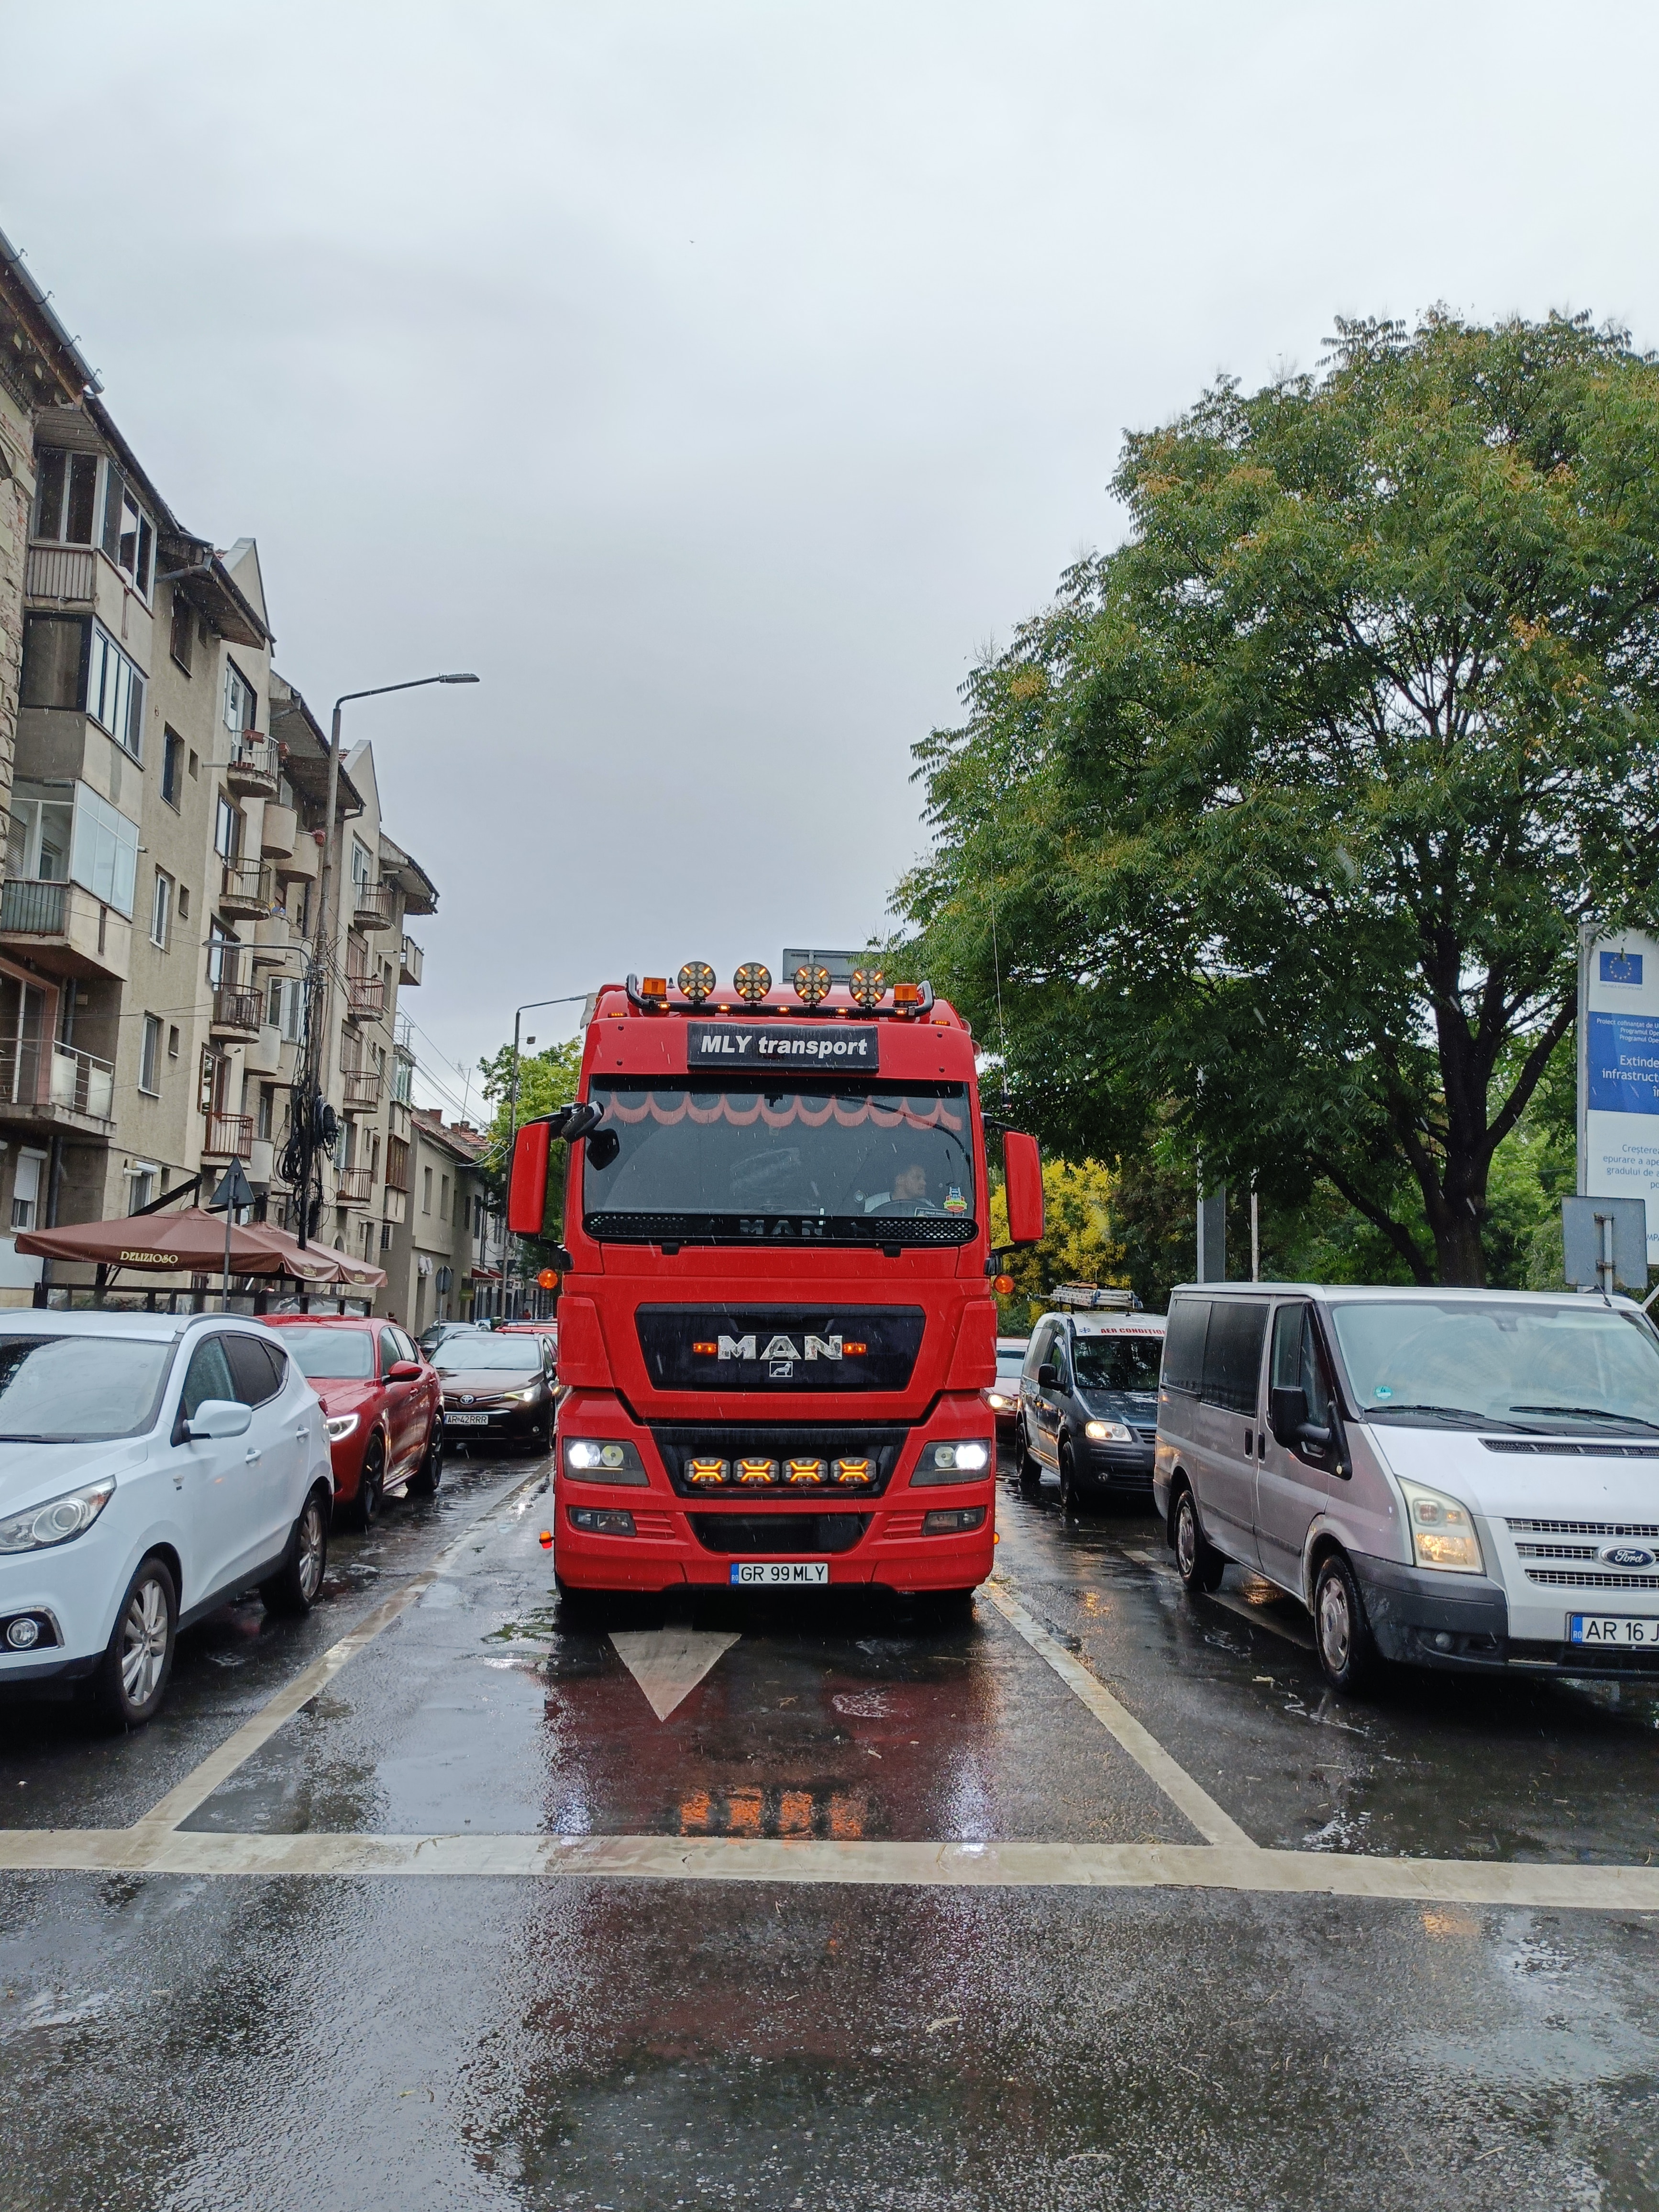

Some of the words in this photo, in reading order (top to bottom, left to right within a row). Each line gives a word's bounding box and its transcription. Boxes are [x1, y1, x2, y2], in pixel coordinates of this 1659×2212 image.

[1619, 1034, 1647, 1042] Programul
[1620, 1027, 1648, 1035] Programul
[701, 1035, 752, 1053] MLY
[758, 1036, 868, 1059] transport
[1620, 1055, 1659, 1068] Extinde
[1602, 1068, 1659, 1083] infrastruct
[1603, 1156, 1636, 1164] epurare
[1606, 1167, 1640, 1175] gradului
[1643, 1168, 1654, 1176] de
[740, 1219, 826, 1236] MAN
[120, 1251, 178, 1264] DELIZIOSO
[718, 1336, 842, 1360] MAN
[1615, 1549, 1643, 1563] Ford
[741, 1566, 764, 1582] GR
[771, 1566, 790, 1581] 99
[794, 1566, 825, 1581] MLY
[1573, 1630, 1582, 1639] RO
[1586, 1620, 1617, 1640] AR
[1626, 1622, 1644, 1641] 16
